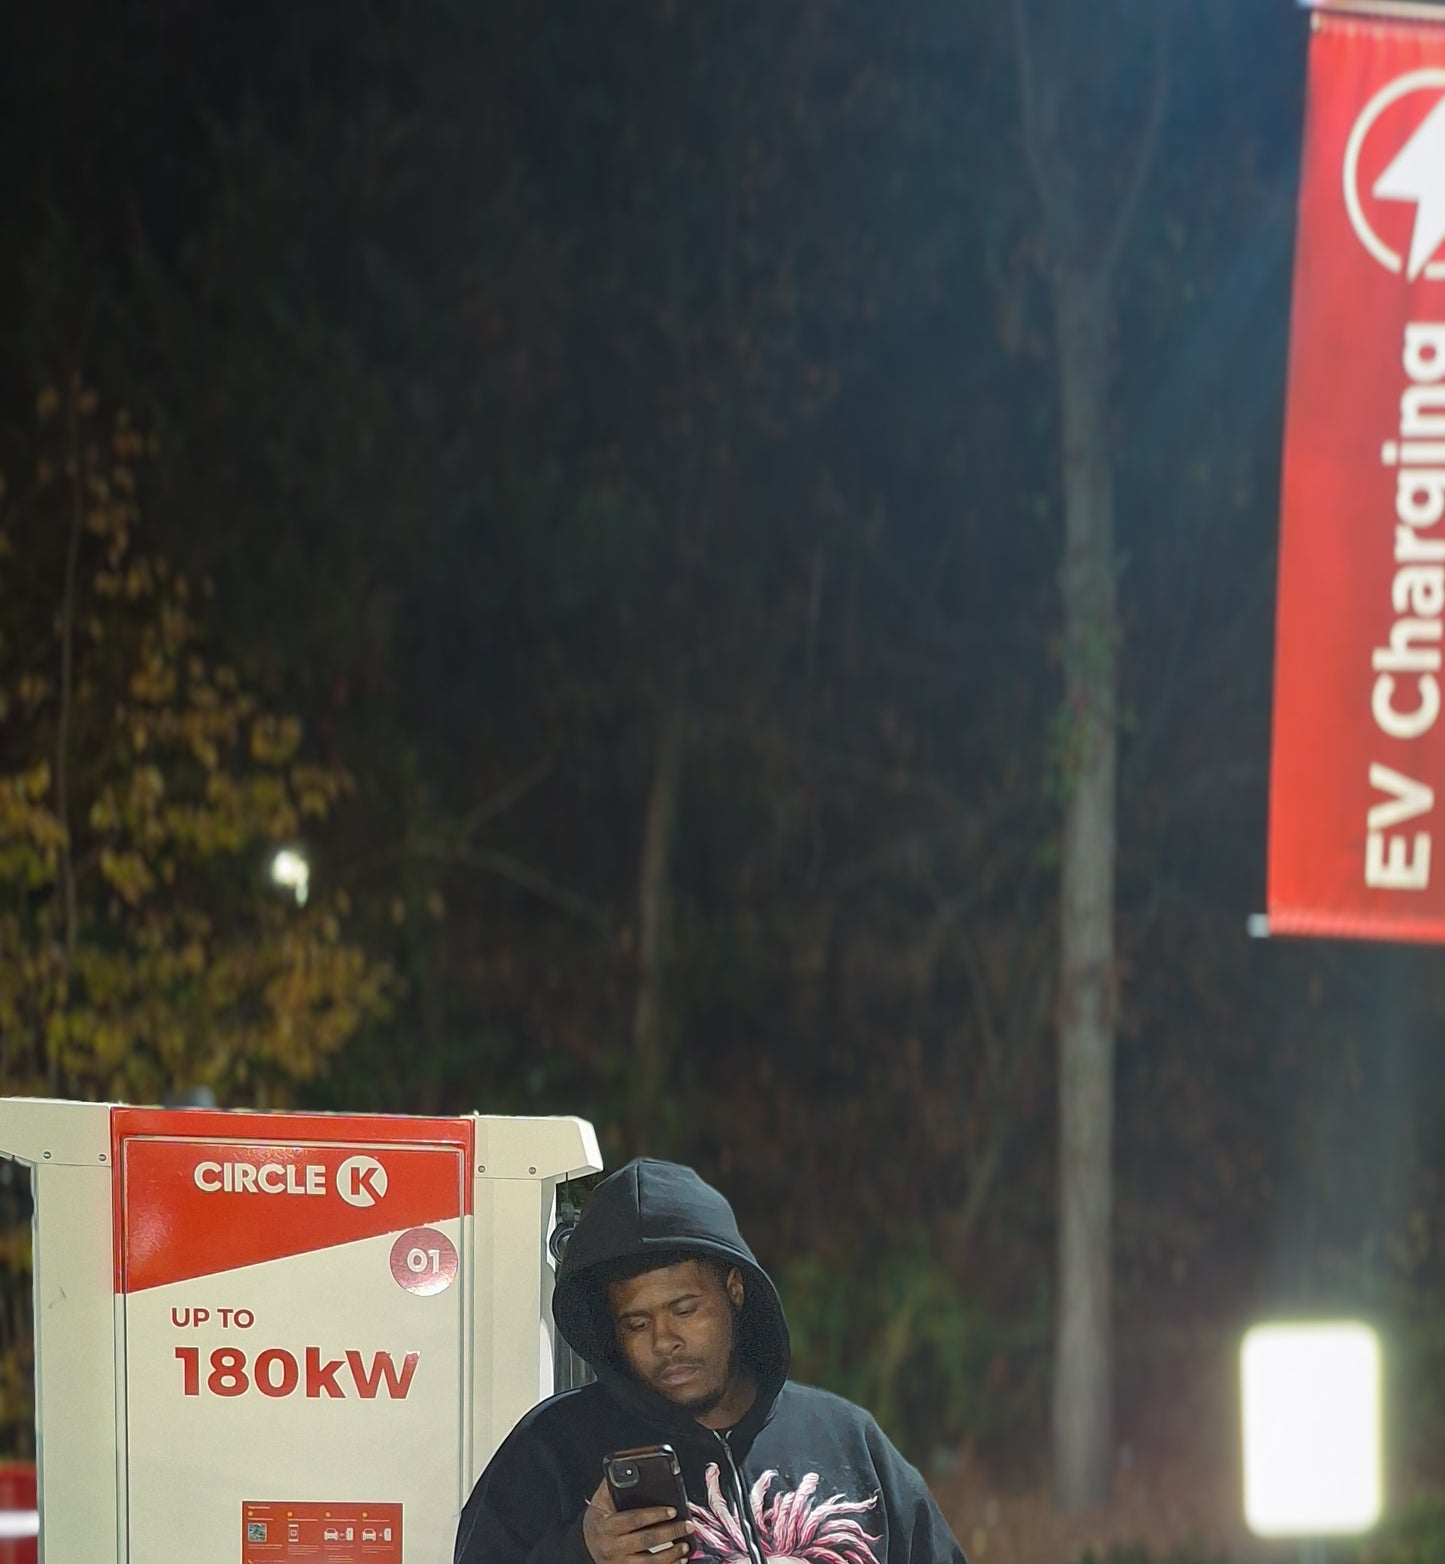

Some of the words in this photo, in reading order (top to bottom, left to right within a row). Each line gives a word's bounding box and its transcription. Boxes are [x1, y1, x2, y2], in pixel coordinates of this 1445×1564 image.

[1365, 762, 1434, 890] EV
[193, 1161, 326, 1195] CIRCLE
[347, 1163, 386, 1205] K
[406, 1247, 440, 1274] 01
[171, 1307, 210, 1328] UP
[217, 1308, 255, 1328] TO
[174, 1345, 421, 1400] 180kW
